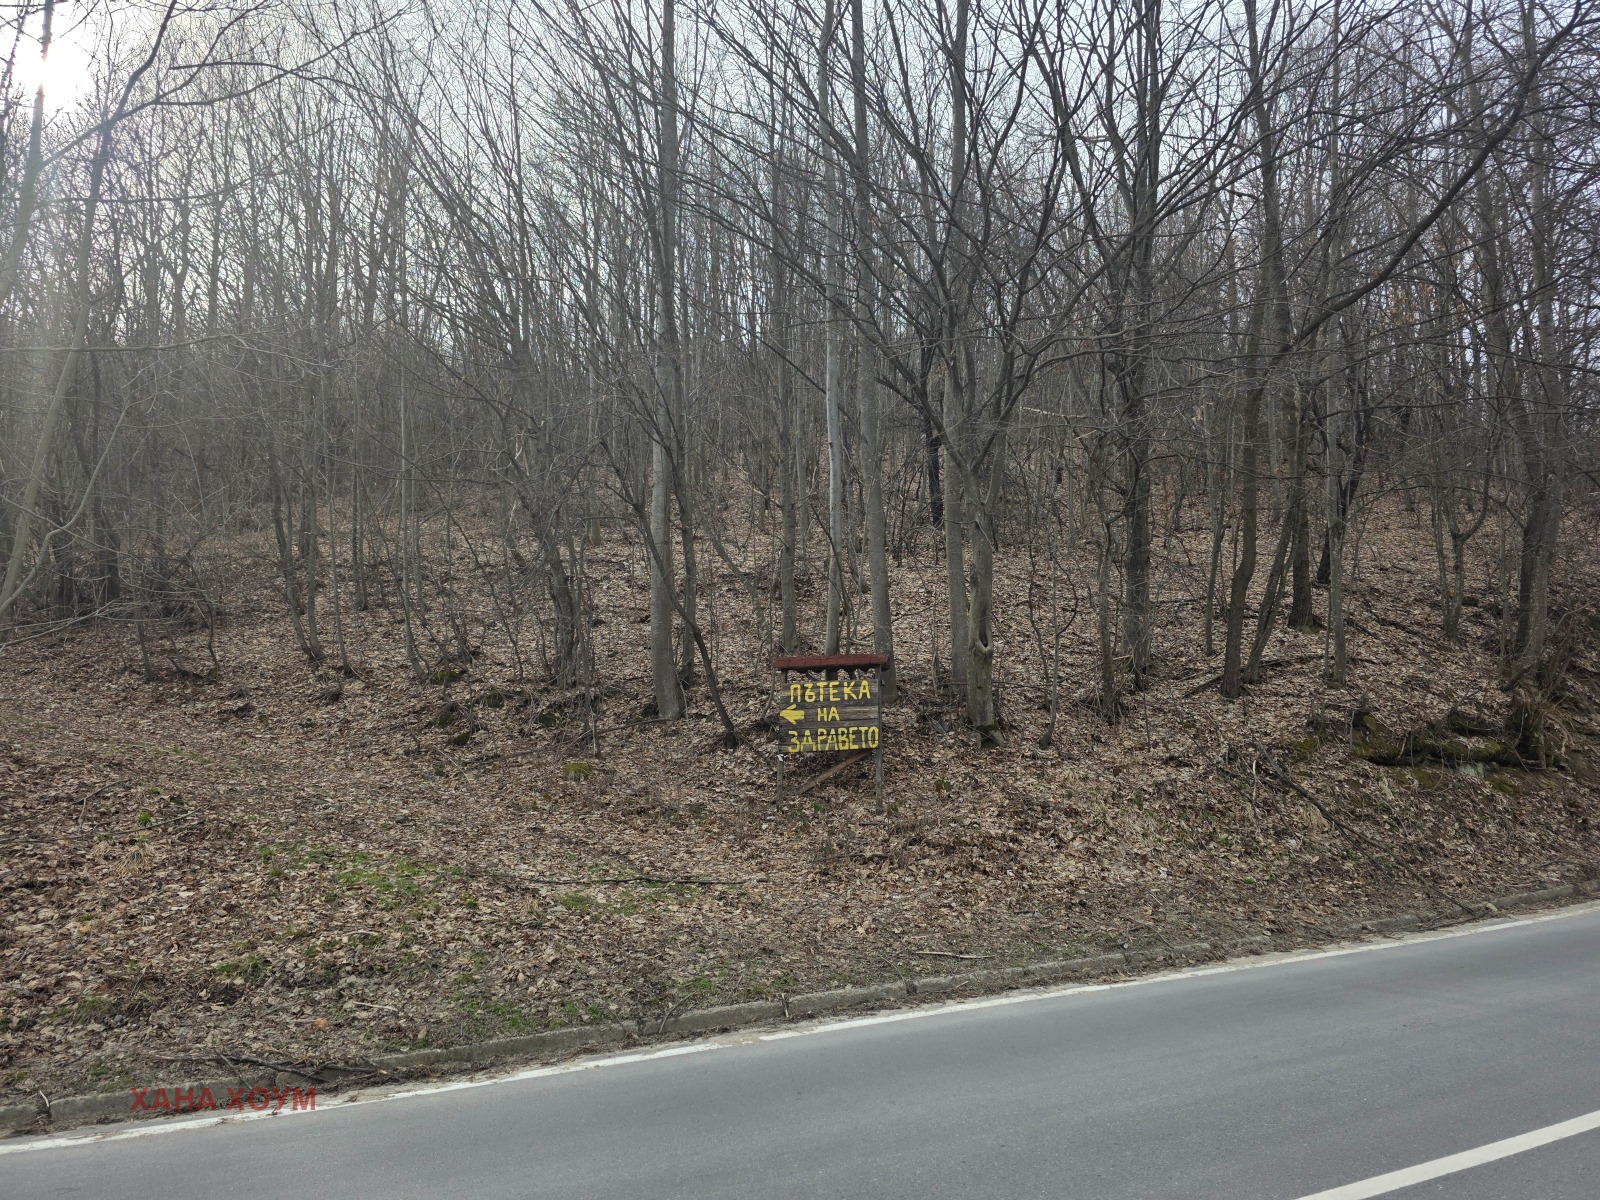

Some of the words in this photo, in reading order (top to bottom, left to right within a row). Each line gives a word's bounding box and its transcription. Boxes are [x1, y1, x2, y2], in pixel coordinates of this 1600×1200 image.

[789, 680, 871, 703] ПЪТЕКА
[817, 707, 840, 721] НА
[787, 726, 879, 753] ЗДРАВЕТО
